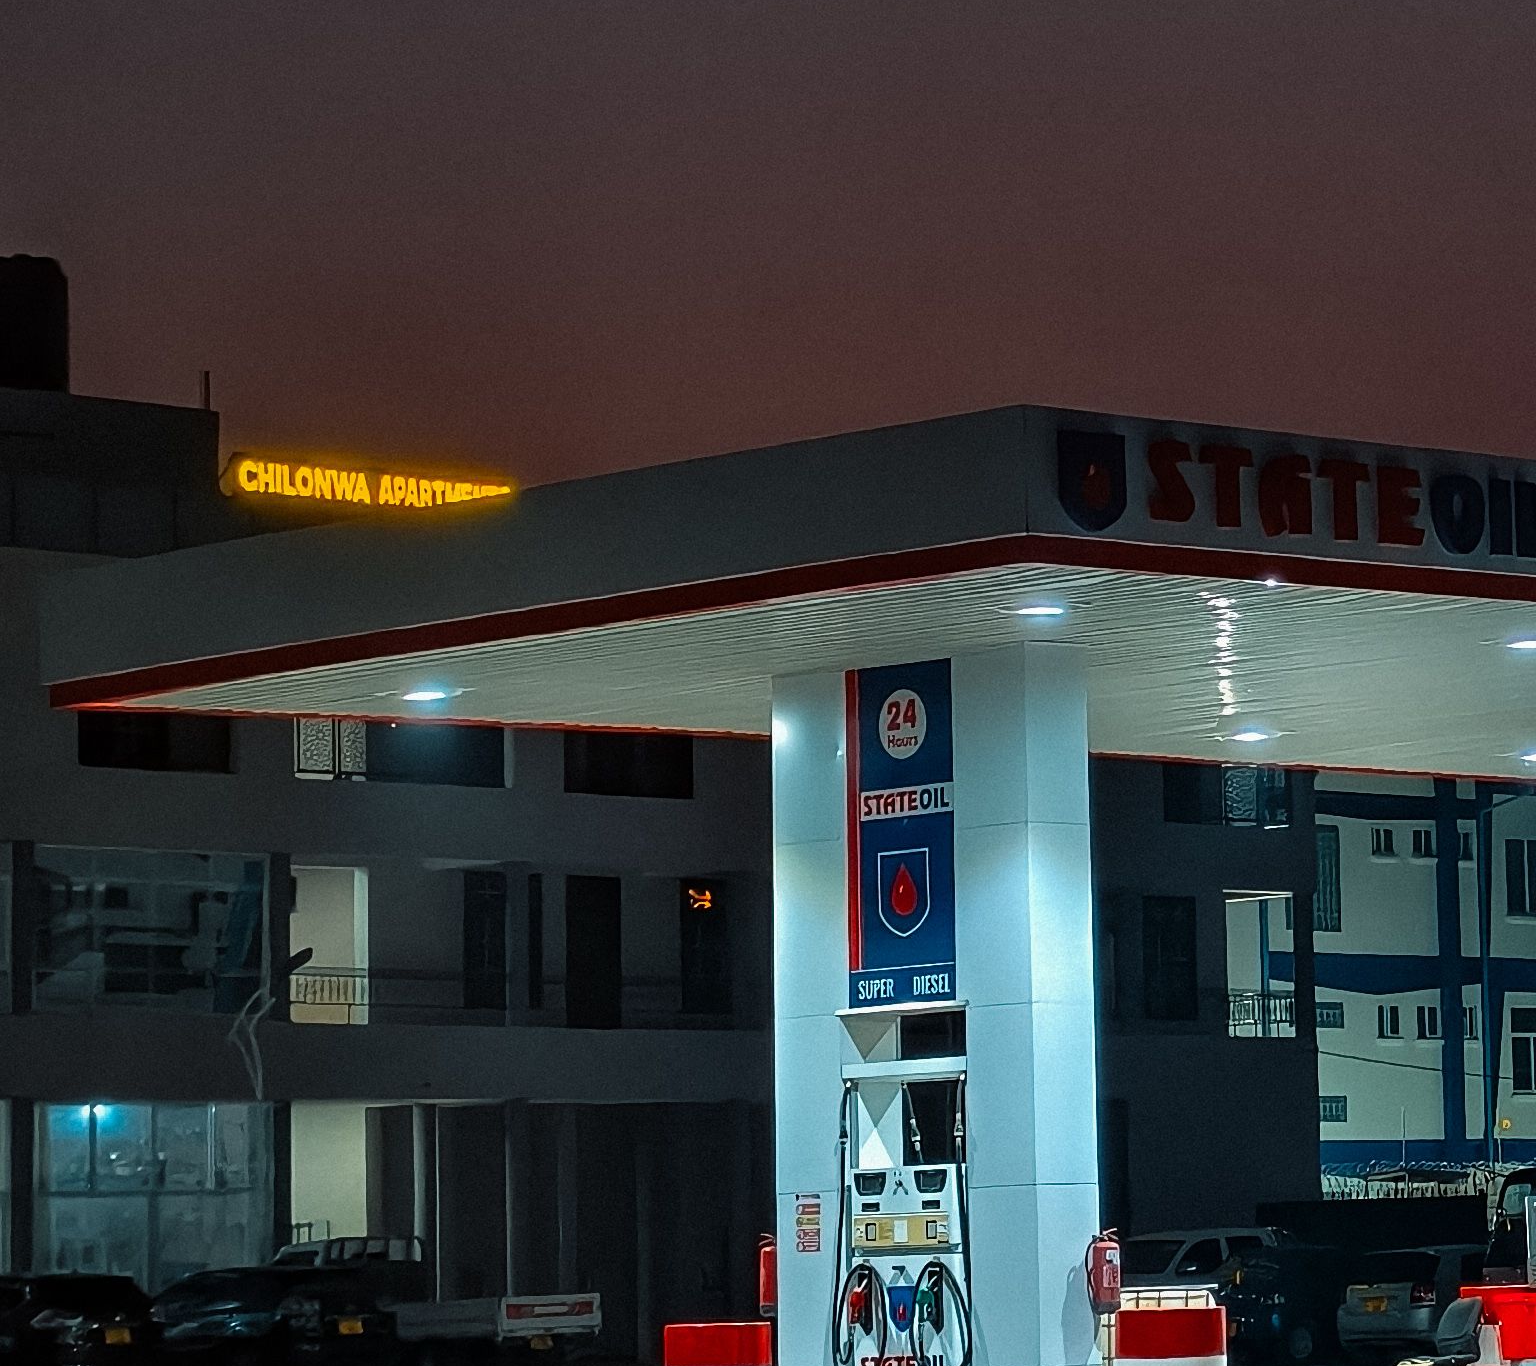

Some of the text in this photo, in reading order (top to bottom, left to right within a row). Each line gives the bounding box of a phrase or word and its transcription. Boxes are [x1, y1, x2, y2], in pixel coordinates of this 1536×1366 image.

[238, 460, 371, 505] CHILONWA
[887, 698, 917, 731] 24
[862, 786, 950, 817] STATEOIL
[857, 973, 951, 1000] SUPER DIESEL
